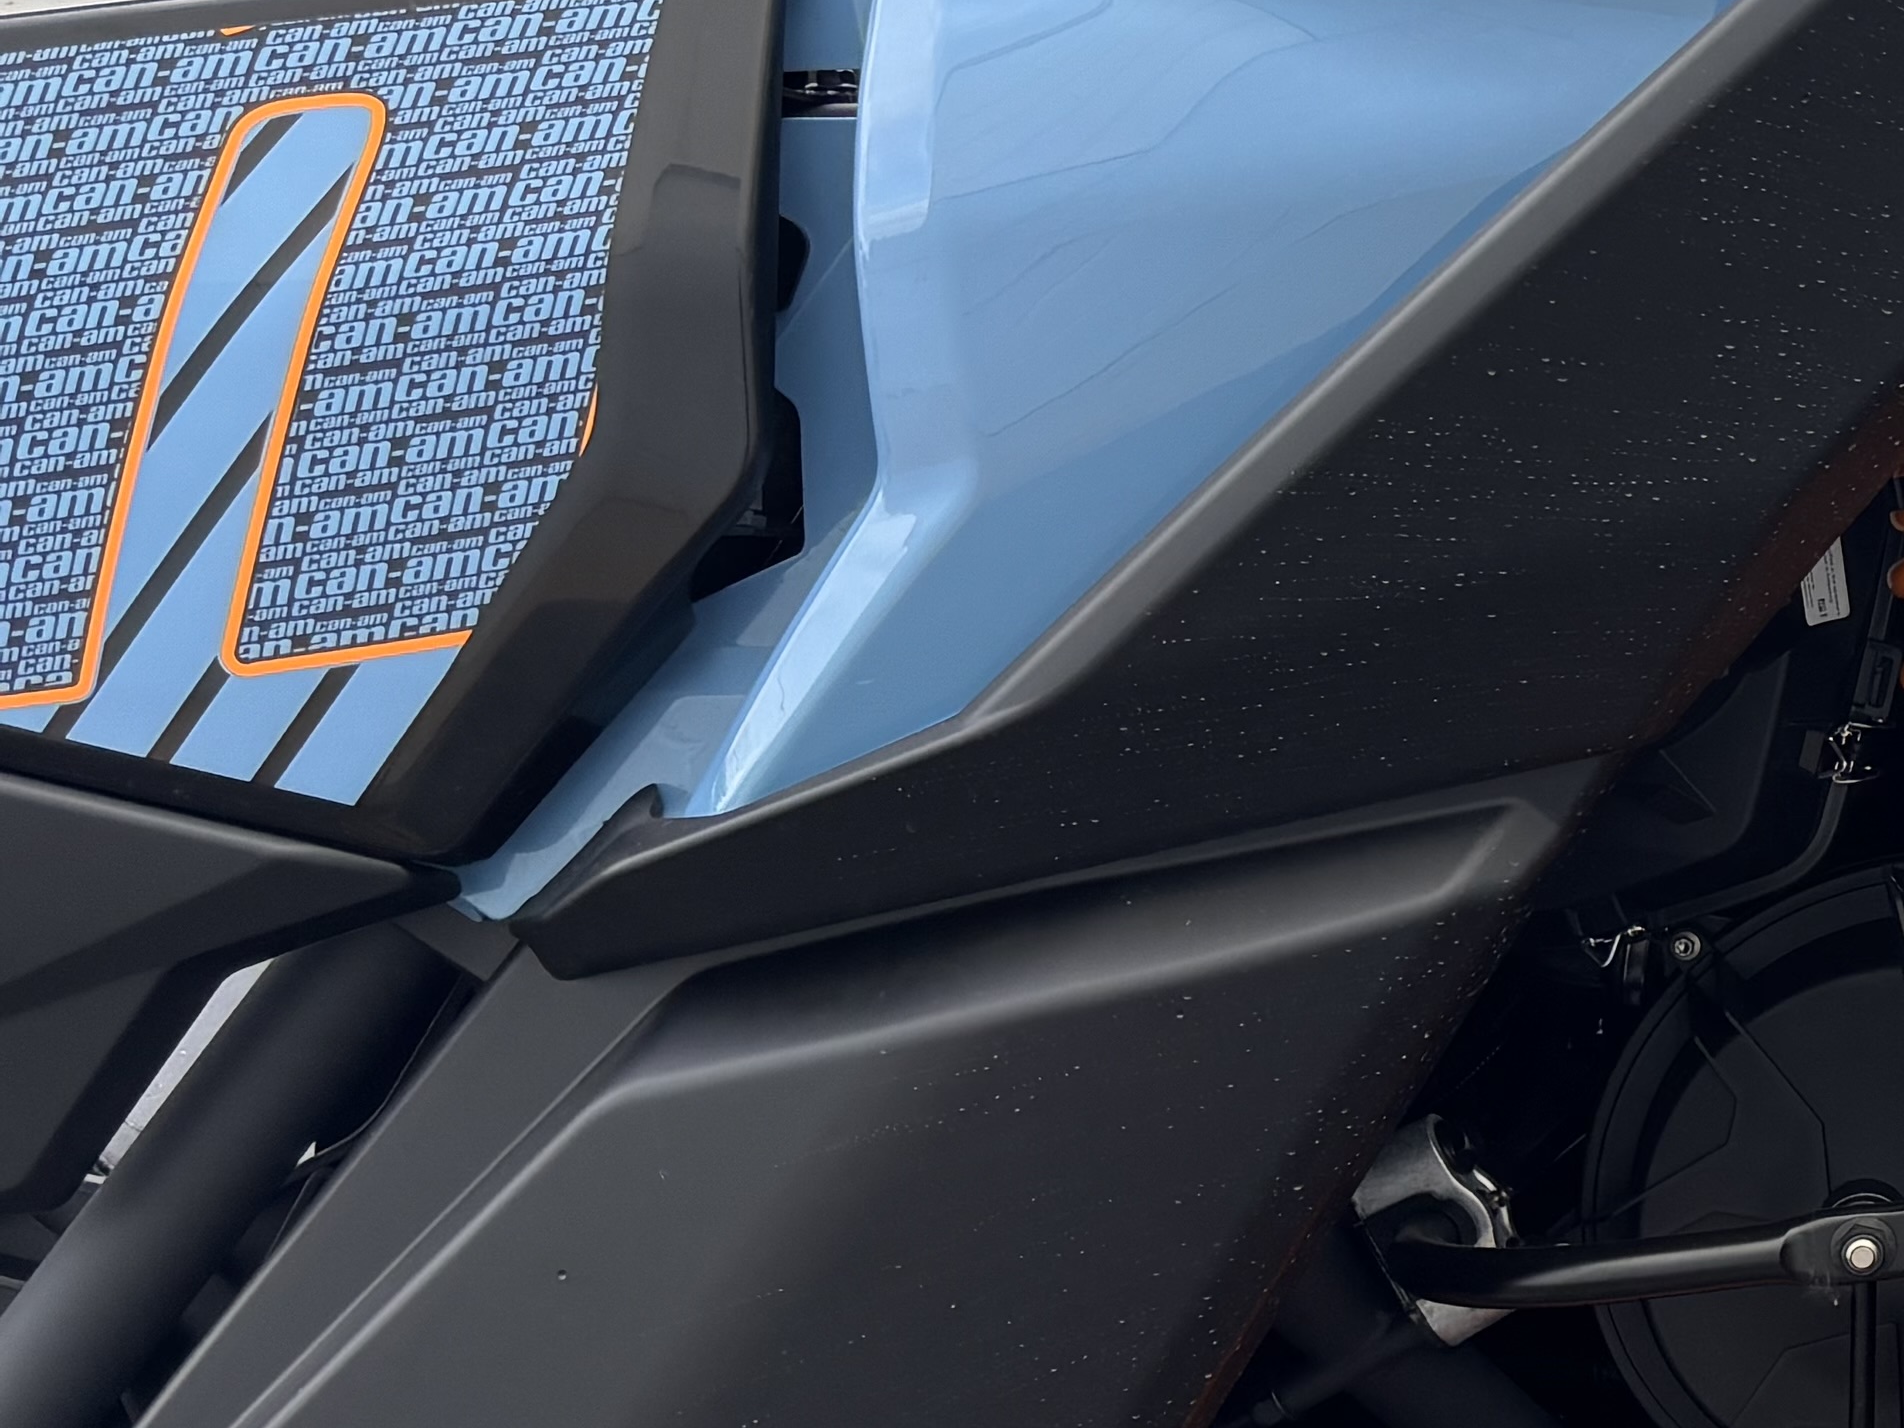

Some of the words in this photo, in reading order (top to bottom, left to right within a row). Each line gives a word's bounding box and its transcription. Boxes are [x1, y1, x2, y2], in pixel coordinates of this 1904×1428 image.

[61, 49, 252, 97] can-am
[254, 24, 445, 73] can-am
[446, 1, 641, 46] can-am
[72, 42, 184, 70] can-am
[184, 37, 256, 57] can-am
[266, 17, 378, 45] can-am
[378, 13, 451, 31] can-am
[56, 86, 161, 113] can-am
[164, 76, 243, 96] can-am
[249, 61, 354, 87] can-am
[356, 51, 438, 72] can-am
[440, 35, 546, 62] can-am
[549, 25, 629, 46] can-am
[78, 108, 152, 127] can-am
[158, 85, 270, 113] can-am
[461, 58, 535, 76] can-am
[441, 95, 522, 116] can-am
[524, 80, 631, 107] can-am
[434, 104, 545, 132] can-am
[545, 100, 618, 118] can-am
[422, 113, 614, 159] can-am
[52, 158, 163, 186] can-am
[59, 147, 140, 168] can-am
[417, 149, 522, 176] can-am
[525, 139, 605, 160] can-am
[438, 172, 512, 190] can-am
[36, 205, 141, 231] can-am
[419, 212, 499, 231] can-am
[502, 194, 611, 221] can-am
[58, 227, 132, 247] can-am
[414, 221, 522, 249] can-am
[522, 217, 595, 235] can-am
[404, 230, 595, 277] can-am
[34, 279, 144, 308] can-am
[41, 266, 120, 288] can-am
[399, 268, 504, 294] can-am
[506, 256, 584, 277] can-am
[421, 290, 494, 310] can-am
[20, 325, 124, 354] can-am
[406, 332, 486, 354] can-am
[488, 315, 596, 343] can-am
[44, 350, 116, 369] can-am
[322, 366, 396, 388] can-am
[402, 343, 512, 373] can-am
[512, 338, 584, 358] can-am
[395, 351, 580, 402] can-am
[29, 390, 108, 413] can-am
[308, 409, 389, 431] can-am
[392, 391, 495, 420] can-am
[498, 379, 575, 400] can-am
[304, 420, 414, 450] can-am
[414, 414, 488, 435] can-am
[296, 428, 485, 478] can-am
[35, 475, 108, 493] can-am
[294, 466, 399, 496] can-am
[402, 454, 480, 478] can-am
[318, 490, 392, 509] can-am
[396, 465, 506, 496] can-am
[22, 515, 99, 537] can-am
[305, 530, 384, 553] can-am
[388, 512, 490, 541] can-am
[301, 542, 411, 572] can-am
[411, 535, 482, 556] can-am
[294, 550, 479, 599] can-am
[292, 588, 395, 617] can-am
[398, 576, 475, 598] can-am
[314, 612, 388, 632] can-am
